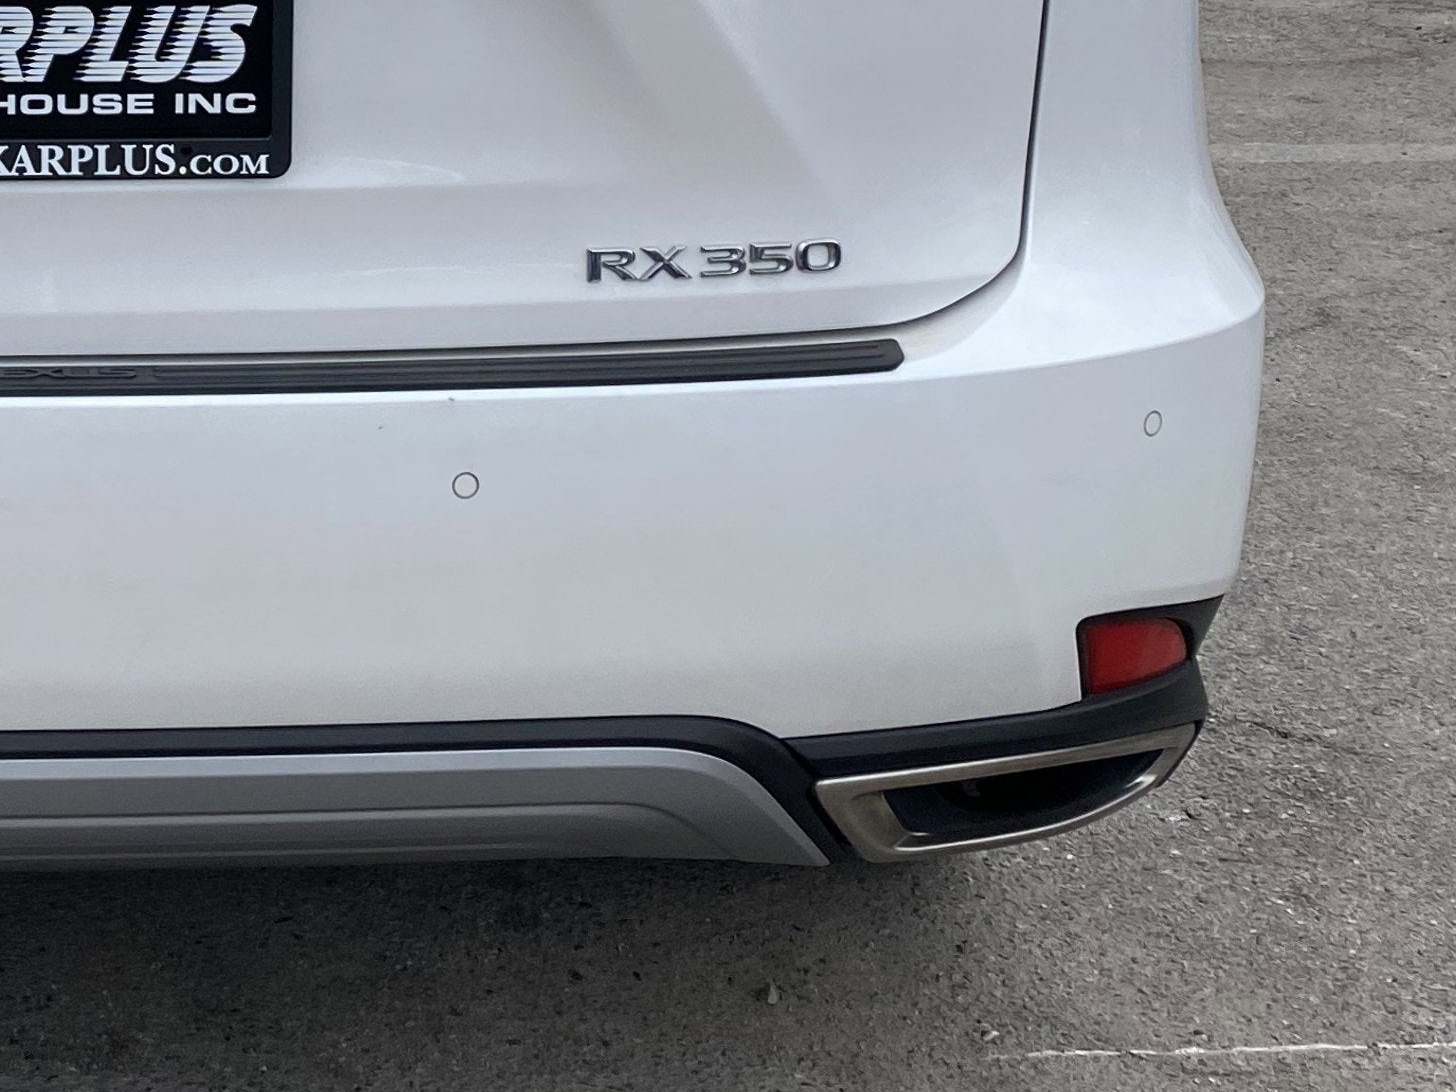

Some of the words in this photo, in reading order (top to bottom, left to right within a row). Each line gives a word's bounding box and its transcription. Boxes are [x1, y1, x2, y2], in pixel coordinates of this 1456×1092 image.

[174, 92, 257, 115] INC
[585, 244, 693, 283] RX
[699, 237, 842, 278] 350
